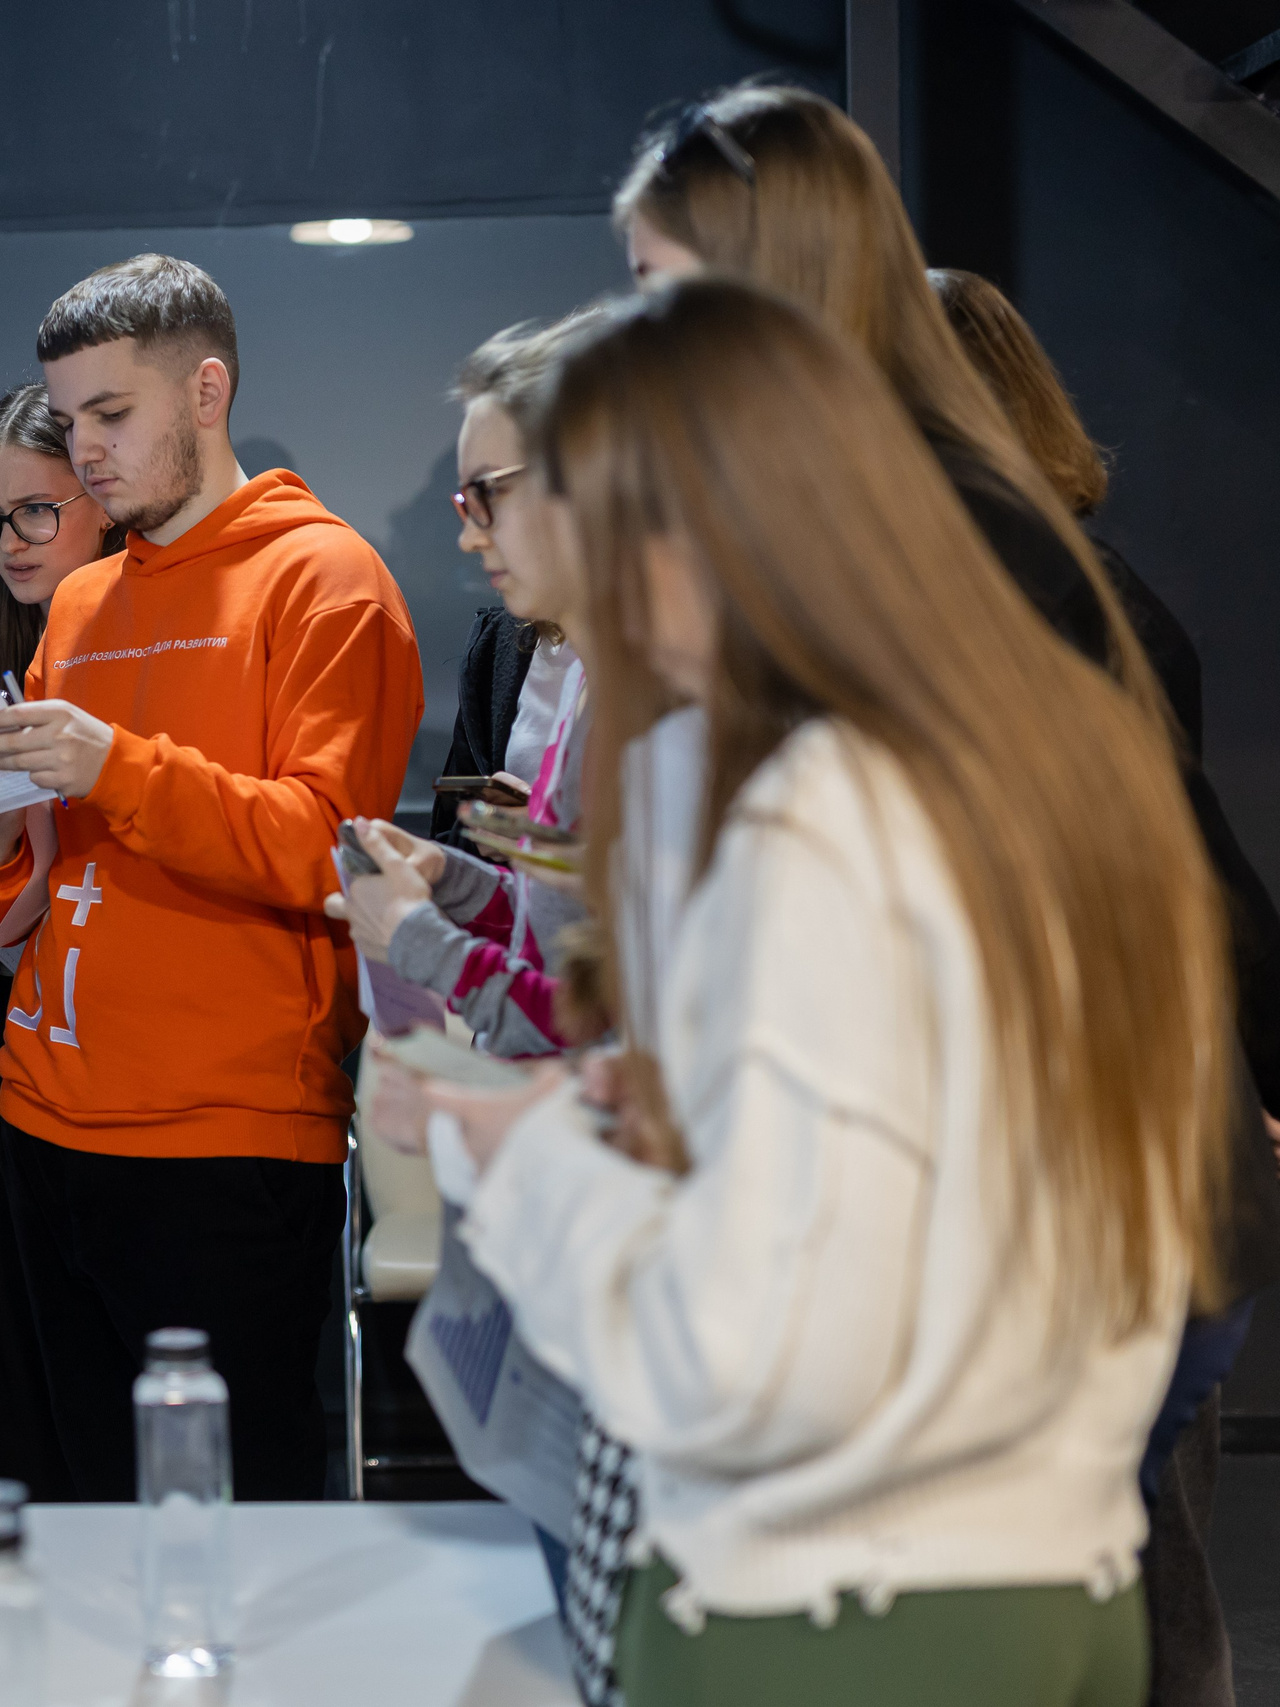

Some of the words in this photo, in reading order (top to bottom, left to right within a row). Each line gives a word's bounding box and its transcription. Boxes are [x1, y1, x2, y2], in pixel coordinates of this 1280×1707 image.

[90, 647, 153, 661] ВОЗМОЖНОСТ
[152, 641, 172, 654] ДЛЯ
[174, 637, 228, 650] РАЗВИТИЯ
